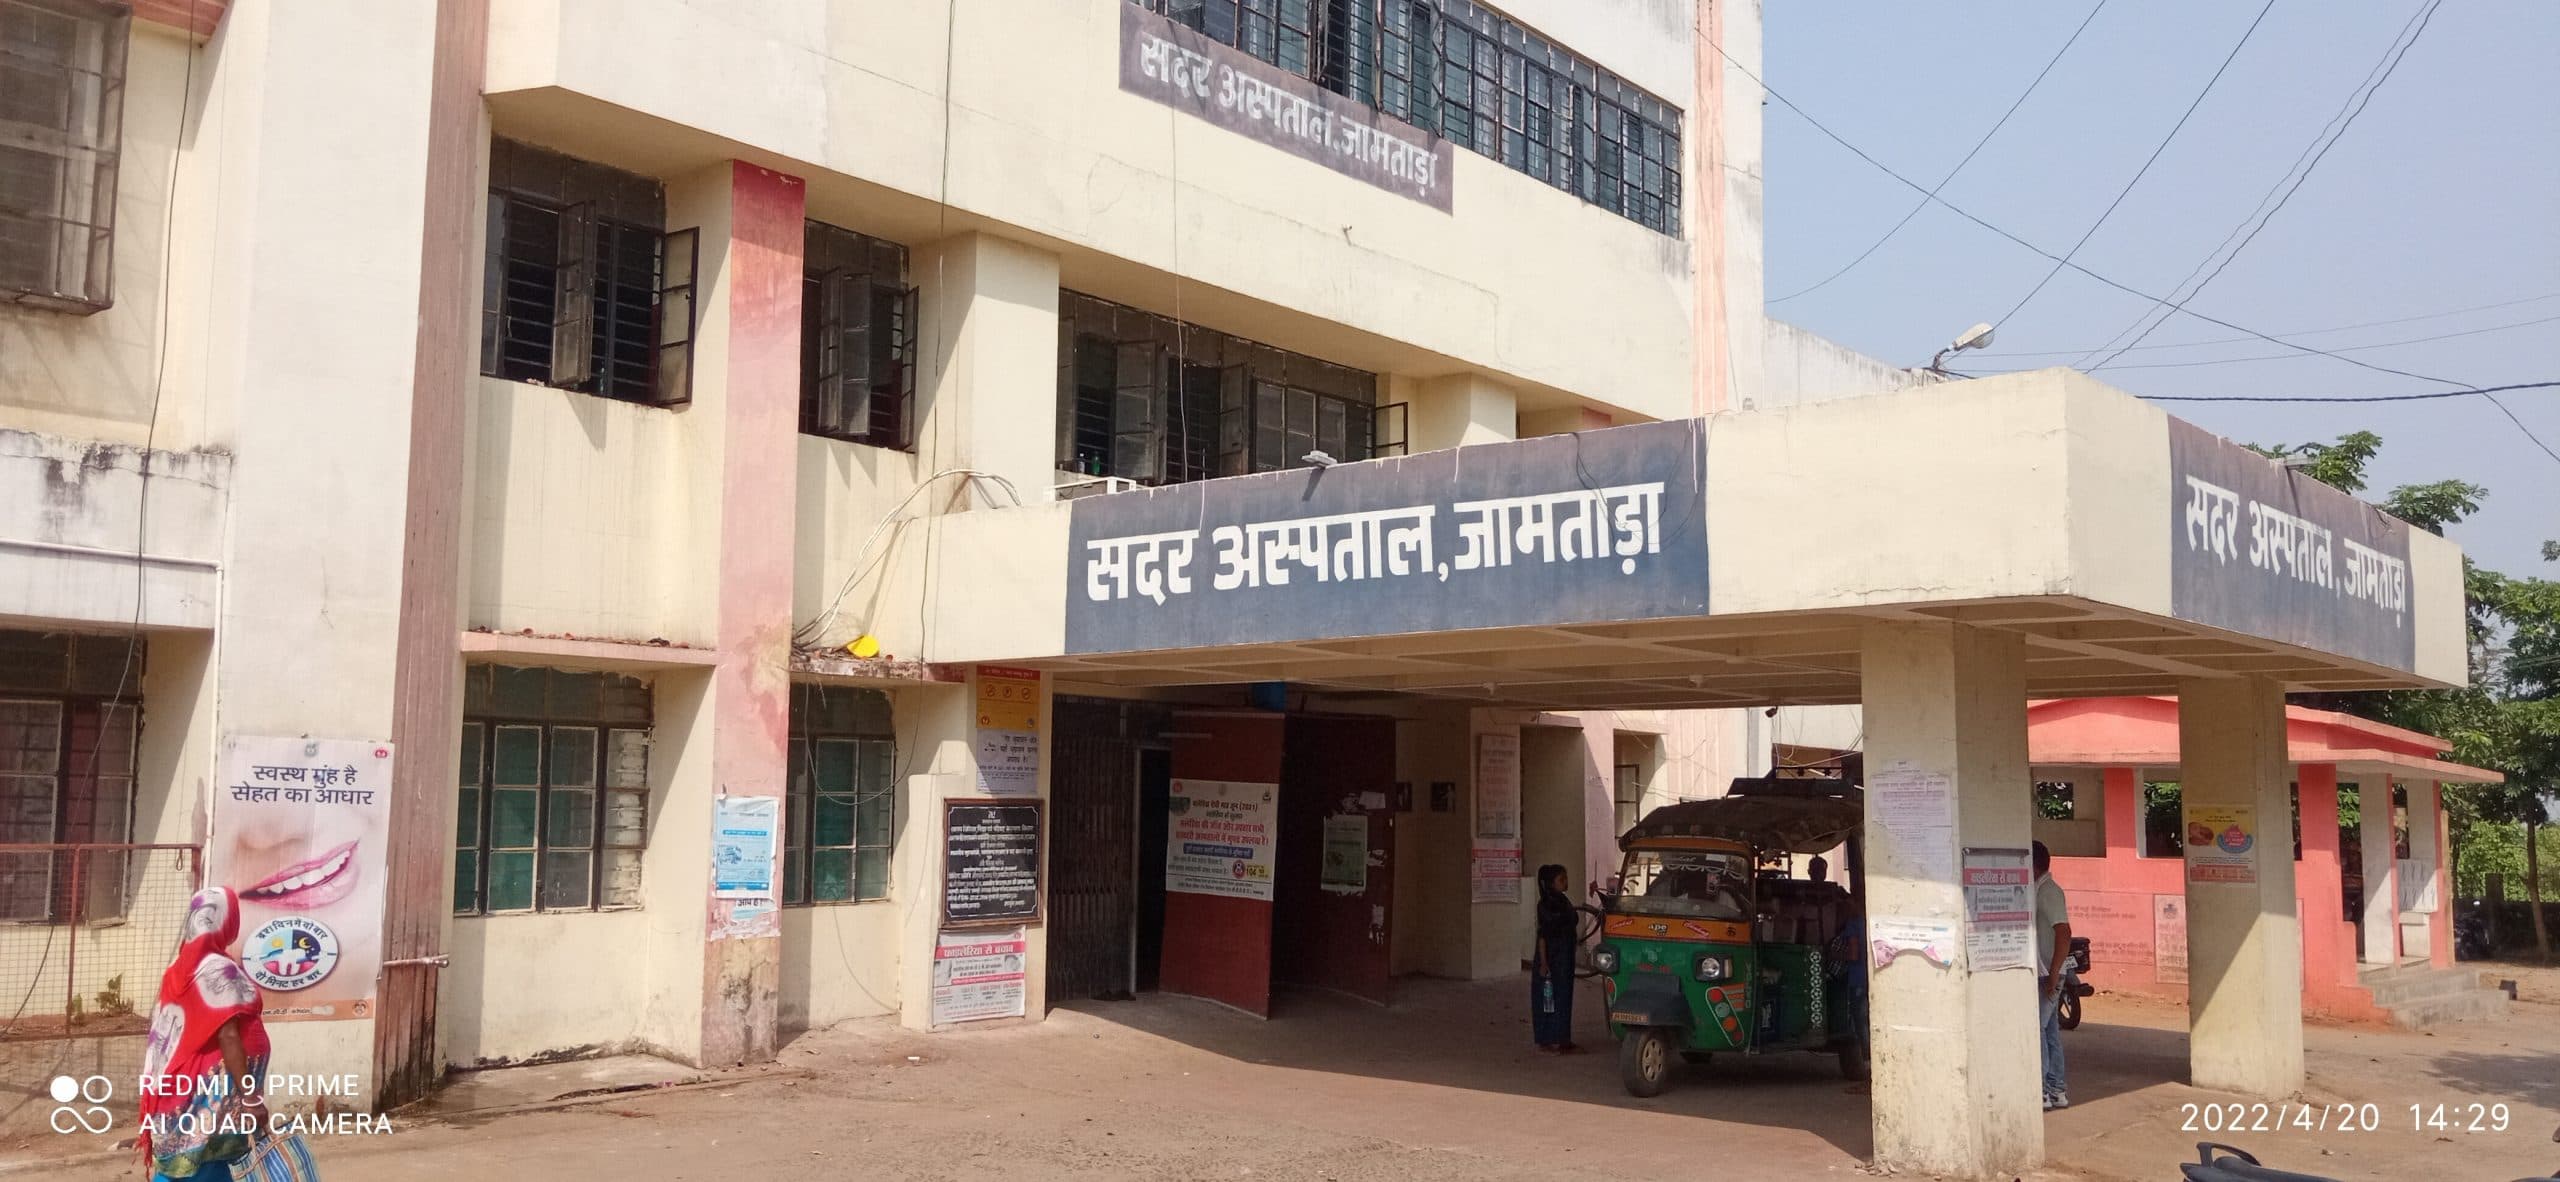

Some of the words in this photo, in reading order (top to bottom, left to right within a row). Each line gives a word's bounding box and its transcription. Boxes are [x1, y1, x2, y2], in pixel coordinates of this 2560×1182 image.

[1141, 31, 1214, 98] सदर
[1087, 529, 1200, 606] सदर
[1454, 482, 1665, 576] जामताड़ा
[2186, 474, 2240, 567] सदर
[2344, 537, 2407, 629] जामताड़ा
[230, 781, 280, 803] सेहत
[285, 787, 312, 803] का
[315, 788, 374, 805] आधार
[252, 765, 308, 782] स्वस्थ
[343, 764, 358, 786] है
